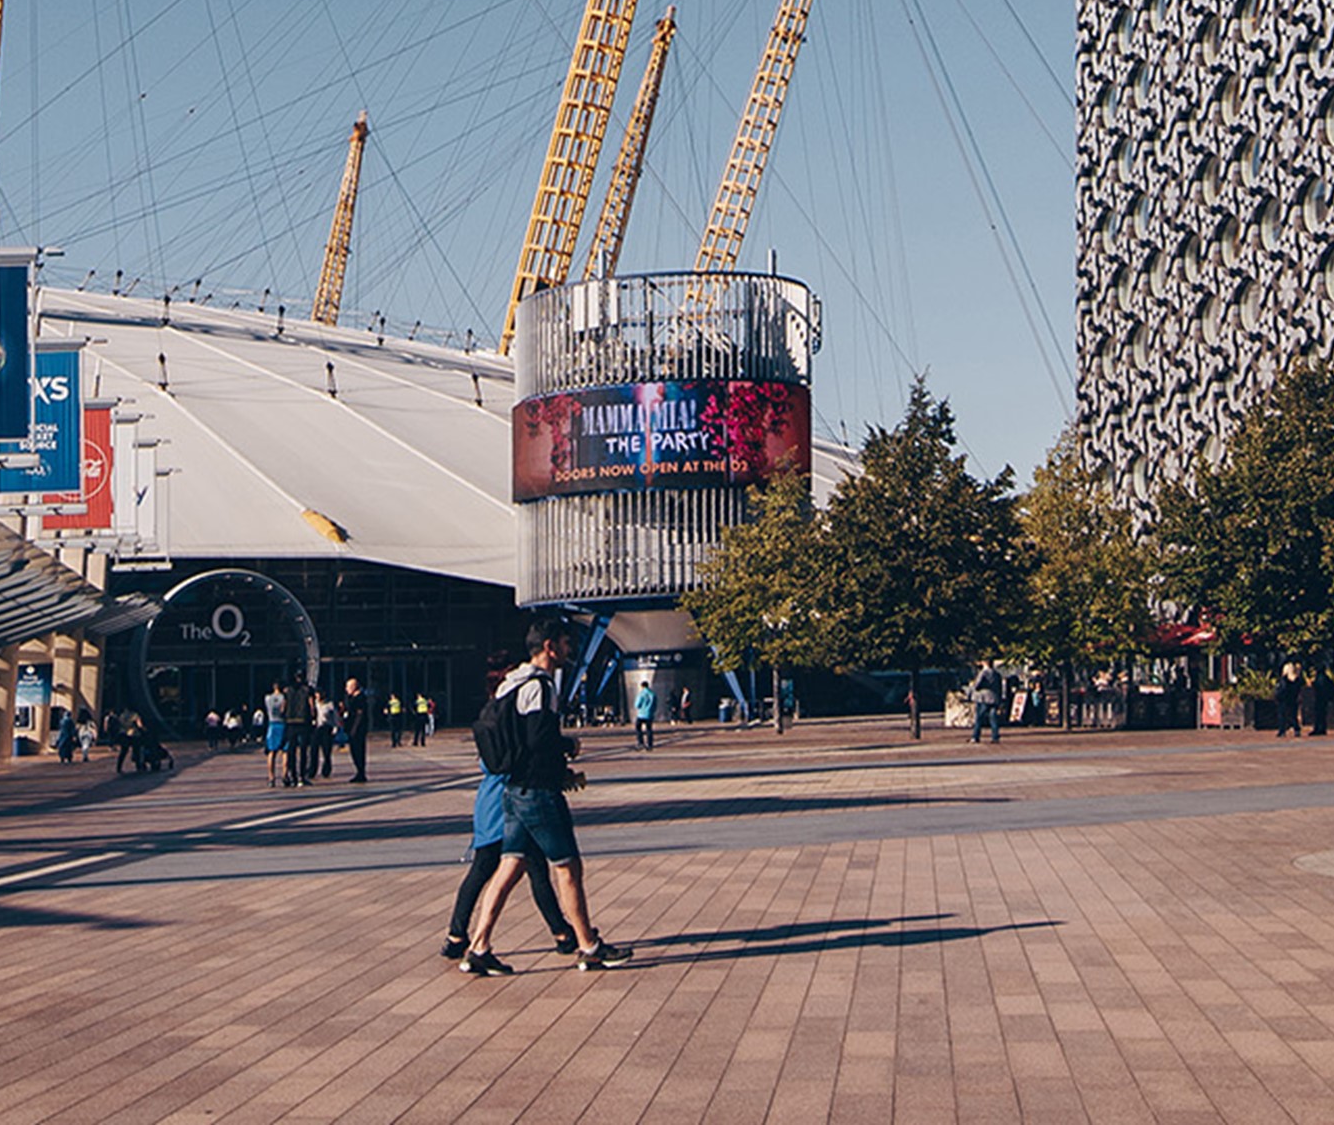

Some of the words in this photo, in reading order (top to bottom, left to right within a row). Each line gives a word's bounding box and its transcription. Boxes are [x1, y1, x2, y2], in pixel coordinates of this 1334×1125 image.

[28, 376, 70, 405] XS
[581, 404, 645, 436] MAMMA
[652, 399, 697, 432] MIA!
[605, 436, 641, 454] THE
[650, 431, 710, 453] PARTY
[555, 465, 595, 482] DOORS
[599, 463, 635, 478] NOW
[639, 461, 678, 474] OPEN
[682, 460, 699, 473] AT
[703, 460, 725, 472] THE
[729, 459, 749, 472] O2
[179, 623, 212, 640] The
